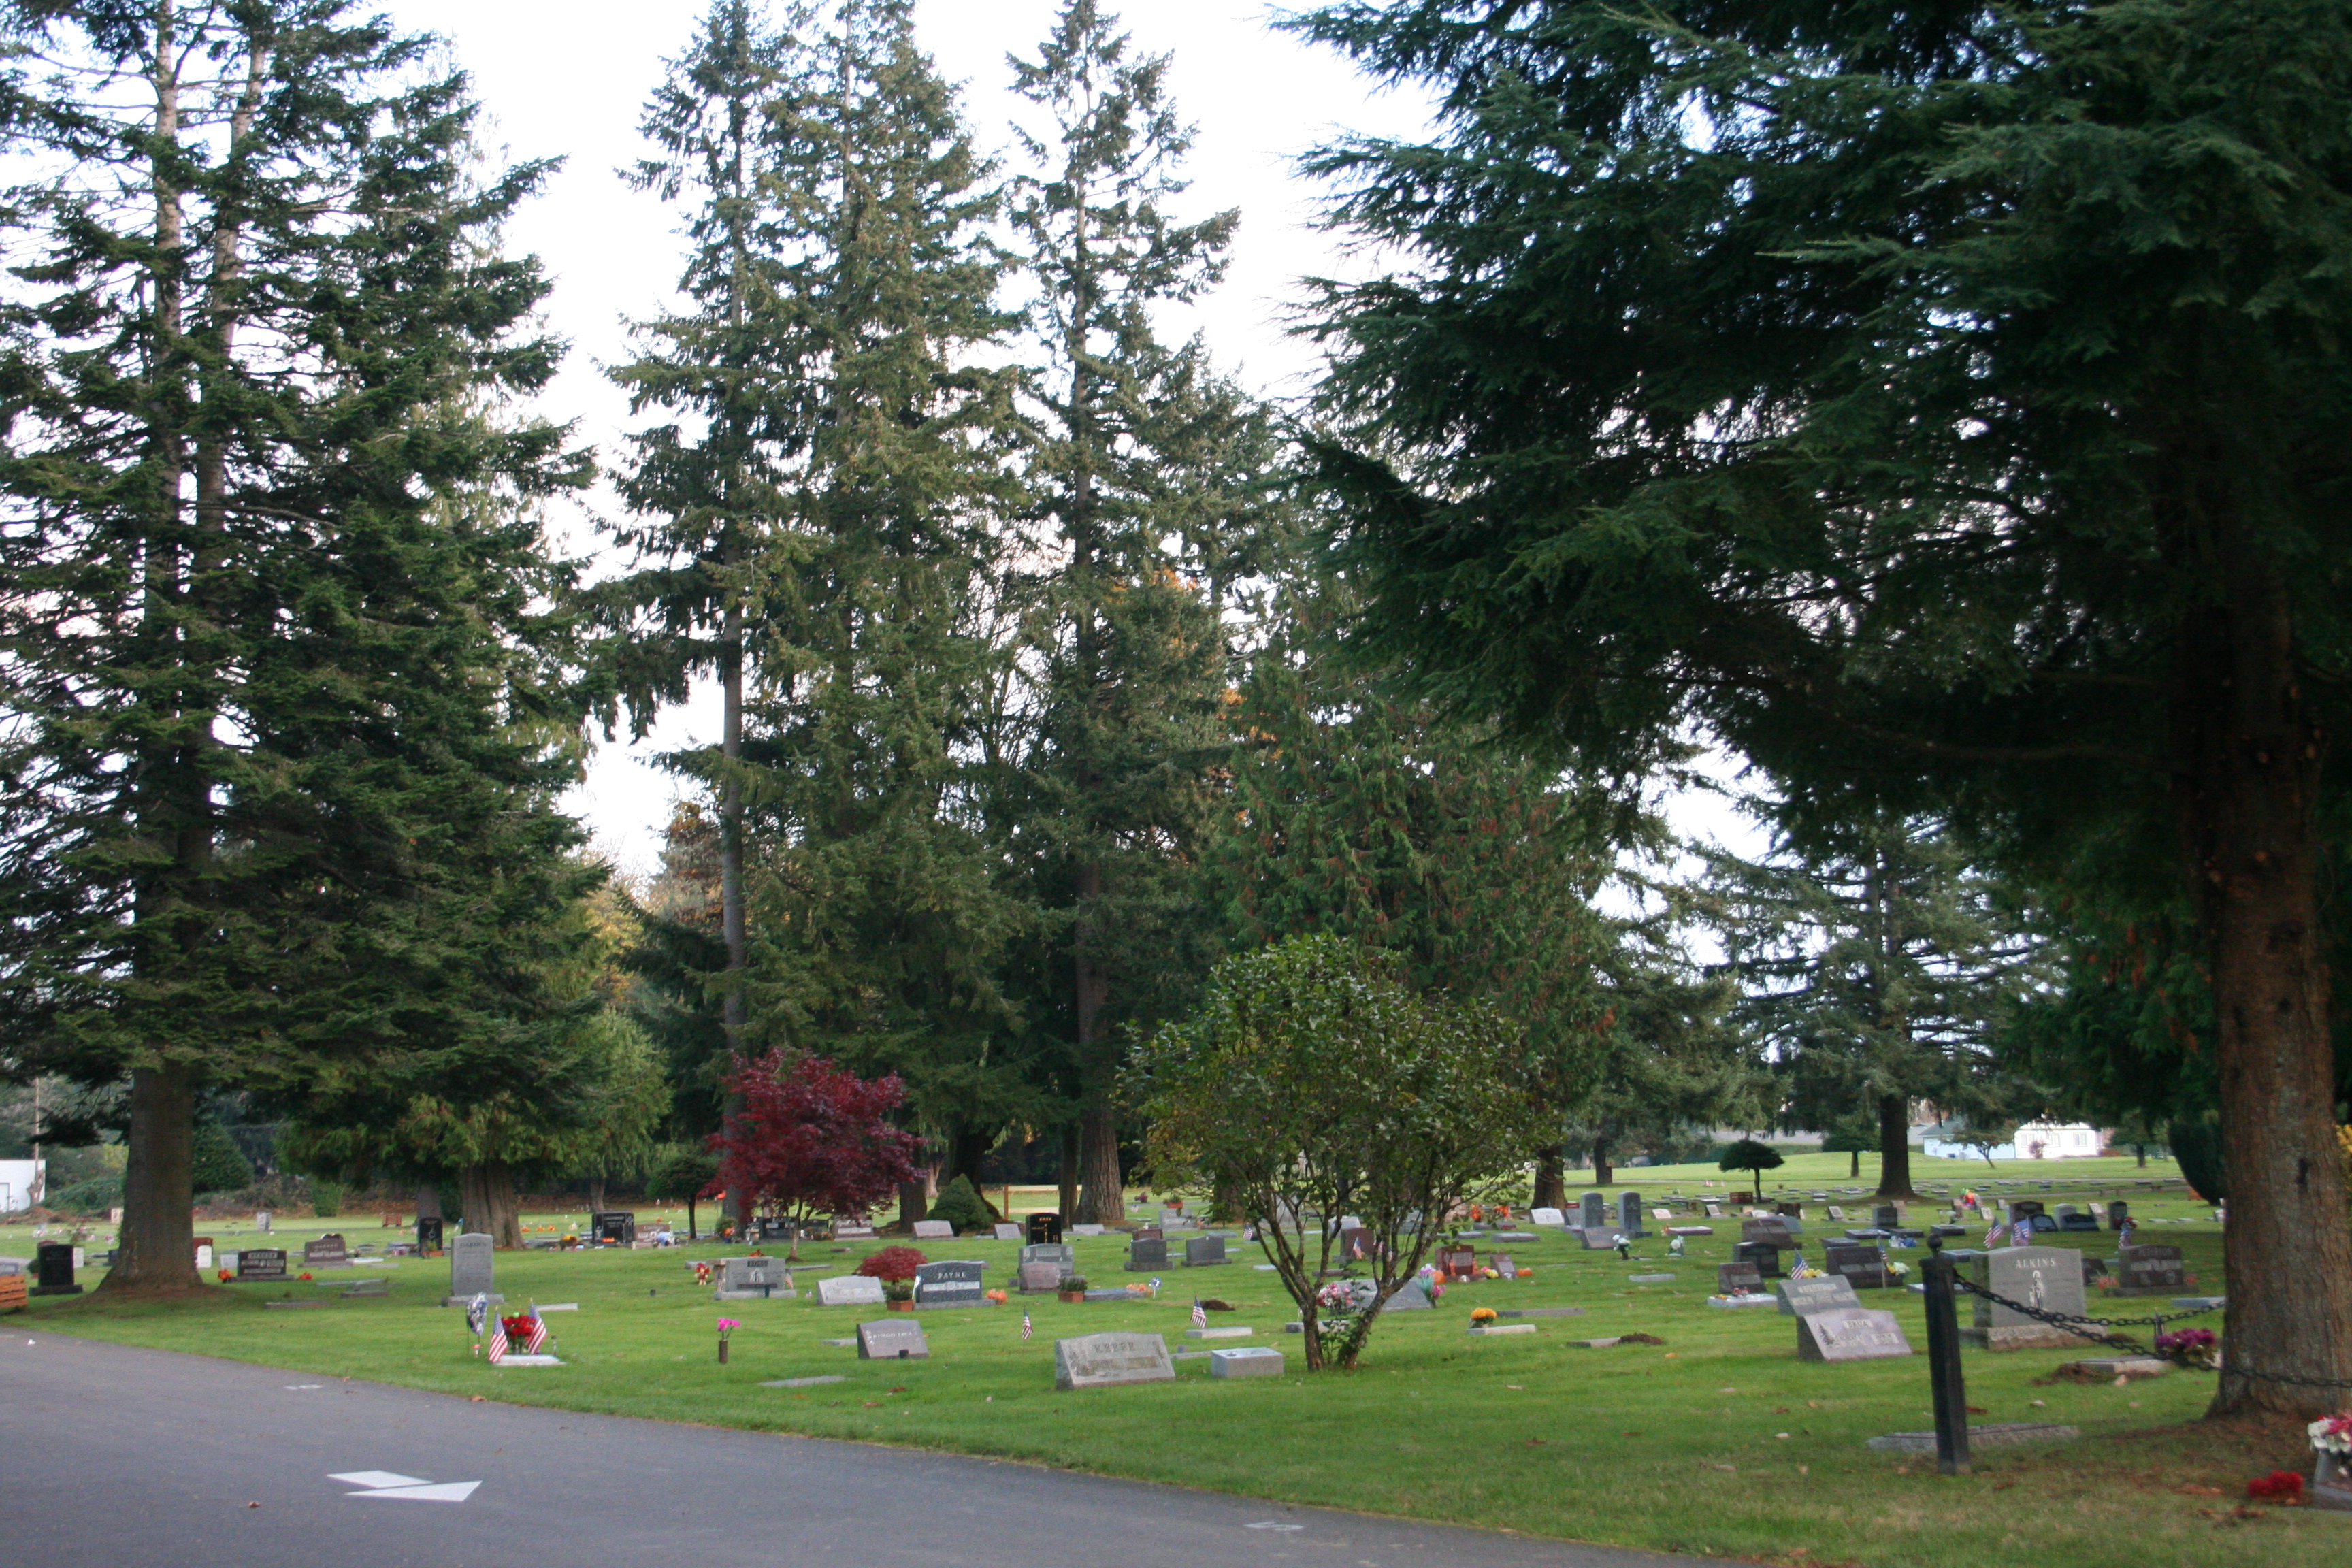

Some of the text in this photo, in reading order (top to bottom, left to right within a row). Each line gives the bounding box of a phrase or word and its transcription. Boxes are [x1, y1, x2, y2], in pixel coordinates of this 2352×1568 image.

[2015, 1257, 2055, 1269] ALKINS
[938, 1271, 966, 1280] PAYNE
[1092, 1341, 1135, 1353] KEEFE
